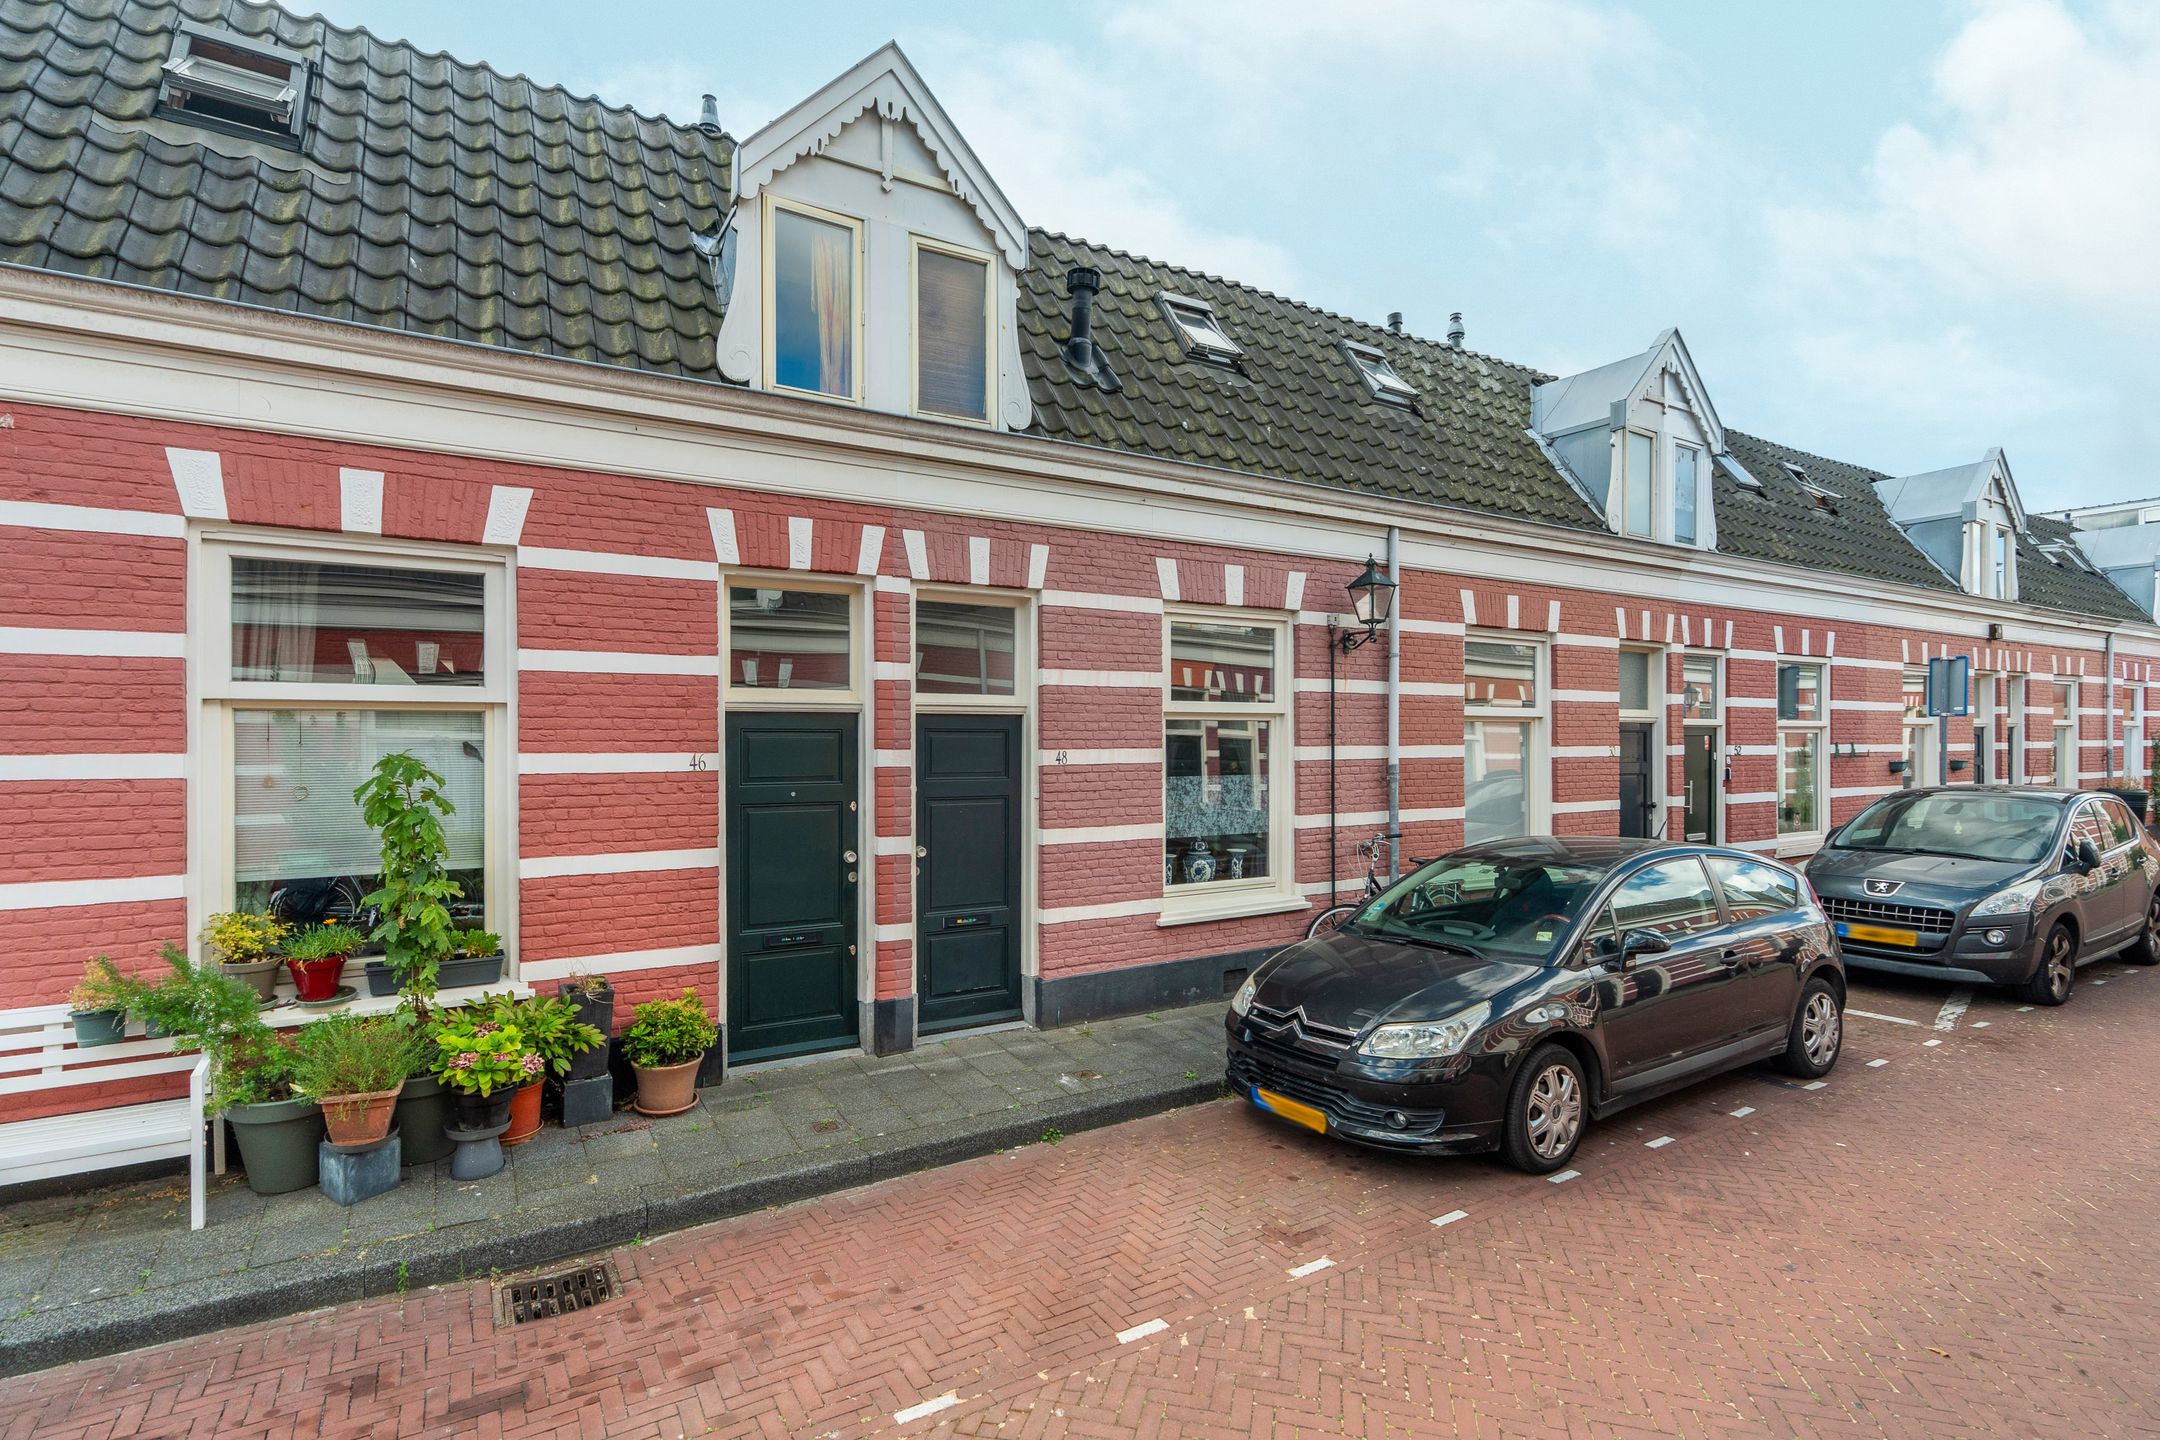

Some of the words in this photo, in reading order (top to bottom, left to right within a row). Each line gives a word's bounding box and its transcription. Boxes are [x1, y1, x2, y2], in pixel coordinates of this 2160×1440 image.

[1055, 750, 1068, 765] 48
[1734, 745, 1742, 756] 52
[689, 753, 706, 771] 46
